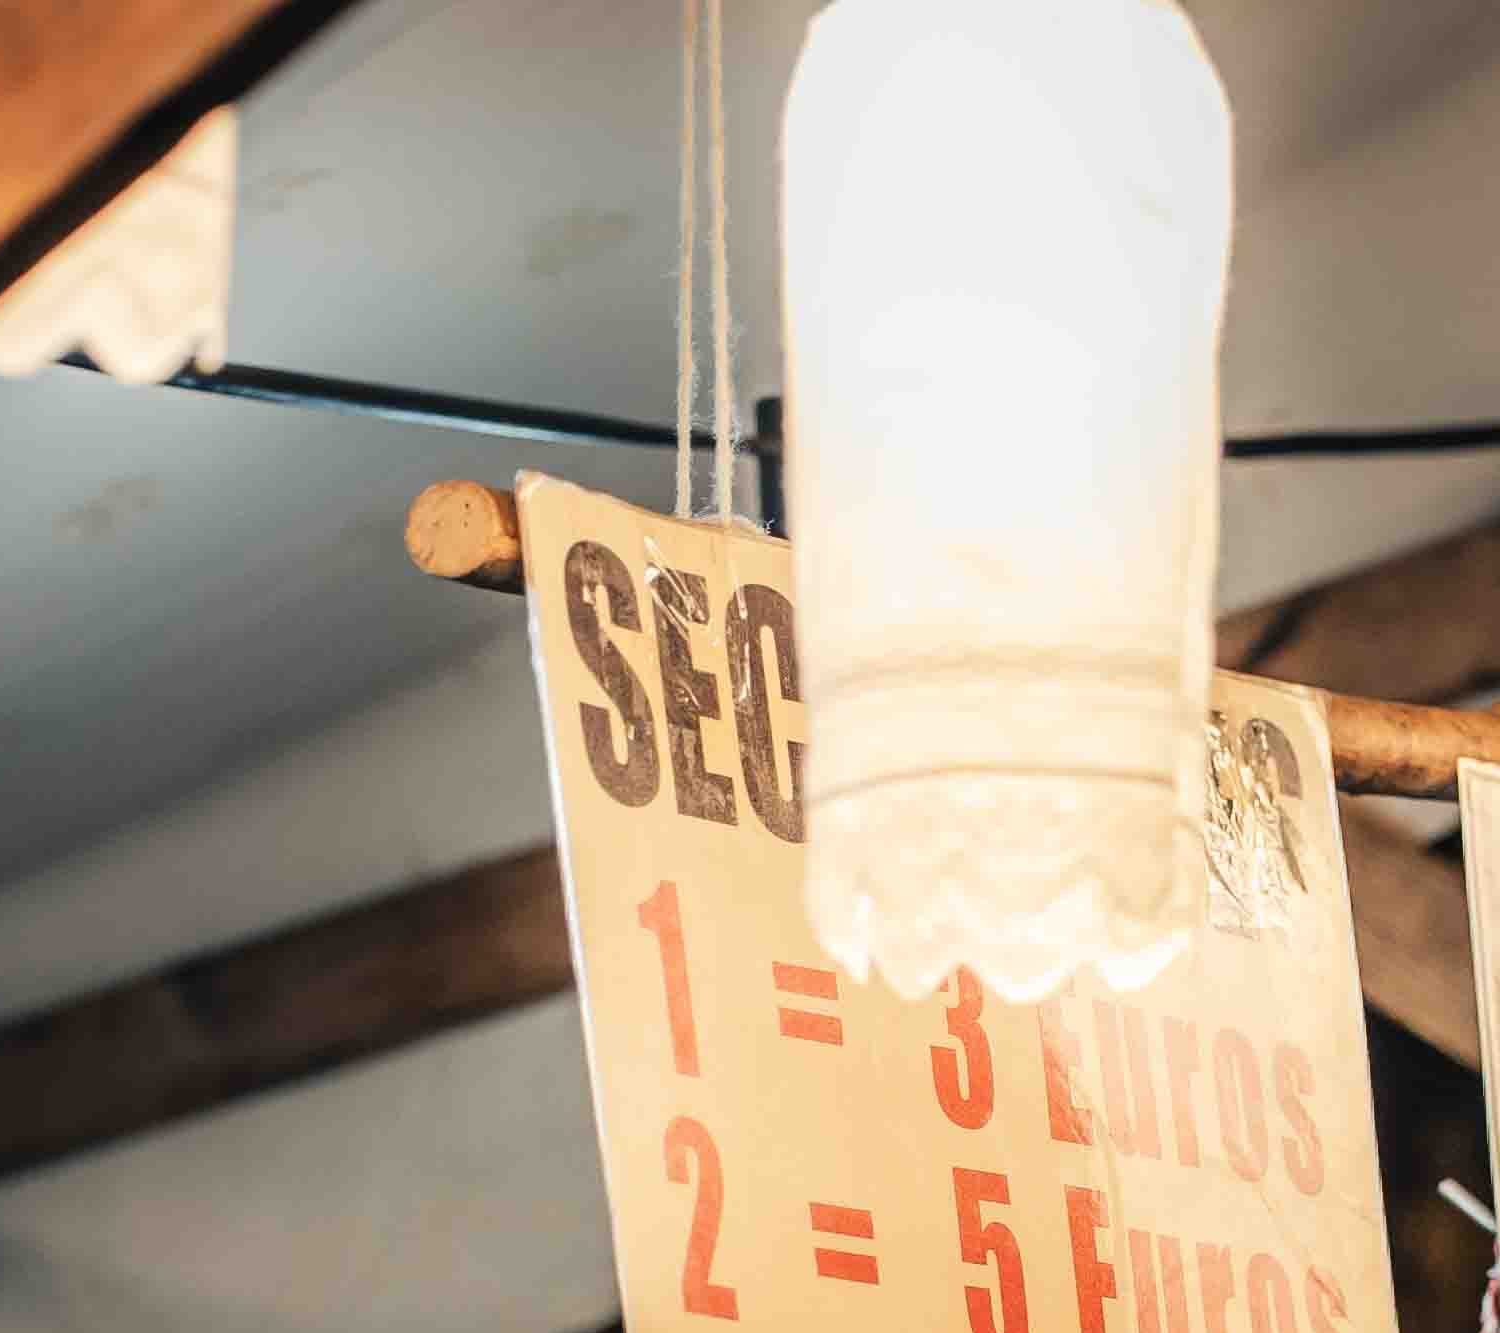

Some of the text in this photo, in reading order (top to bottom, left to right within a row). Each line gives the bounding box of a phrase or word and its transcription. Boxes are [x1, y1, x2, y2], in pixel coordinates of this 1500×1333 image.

[637, 879, 1325, 1197] 1 = 3 Euros
[663, 1114, 740, 1321] 2
[808, 1201, 880, 1286] =
